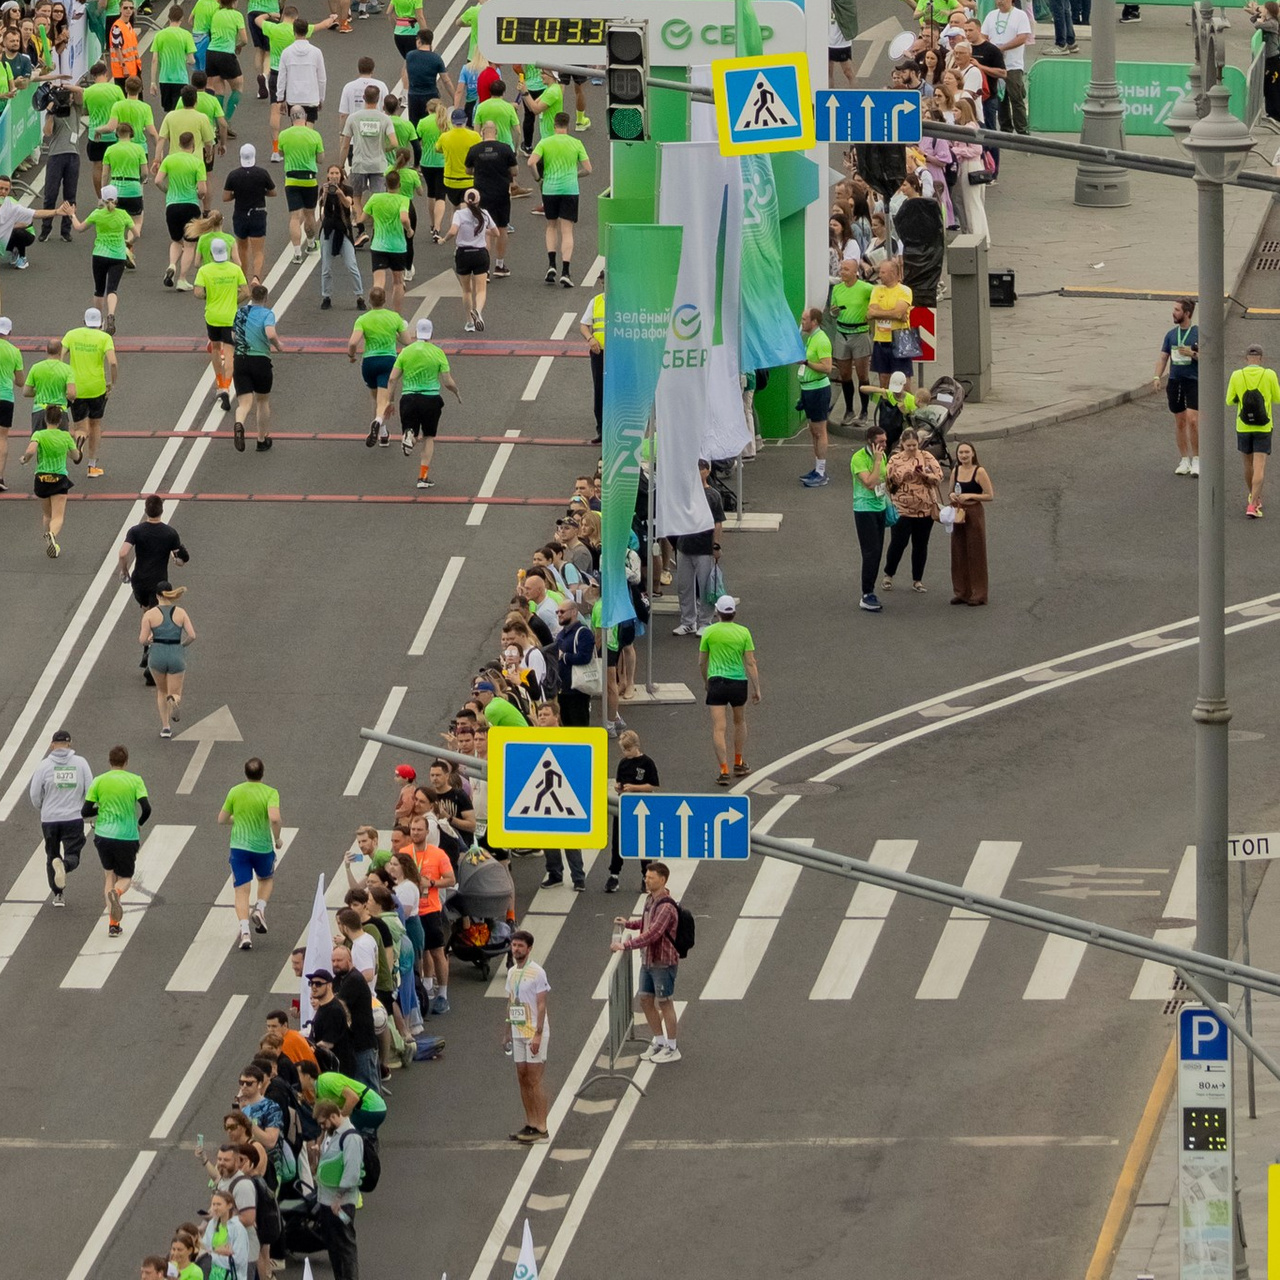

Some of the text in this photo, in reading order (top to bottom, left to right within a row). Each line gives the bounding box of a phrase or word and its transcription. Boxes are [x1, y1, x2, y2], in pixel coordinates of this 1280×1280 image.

[700, 24, 775, 45] СБР
[661, 347, 707, 370] СБЕР
[1228, 838, 1269, 857] ТОП
[1198, 1081, 1211, 1090] 80
